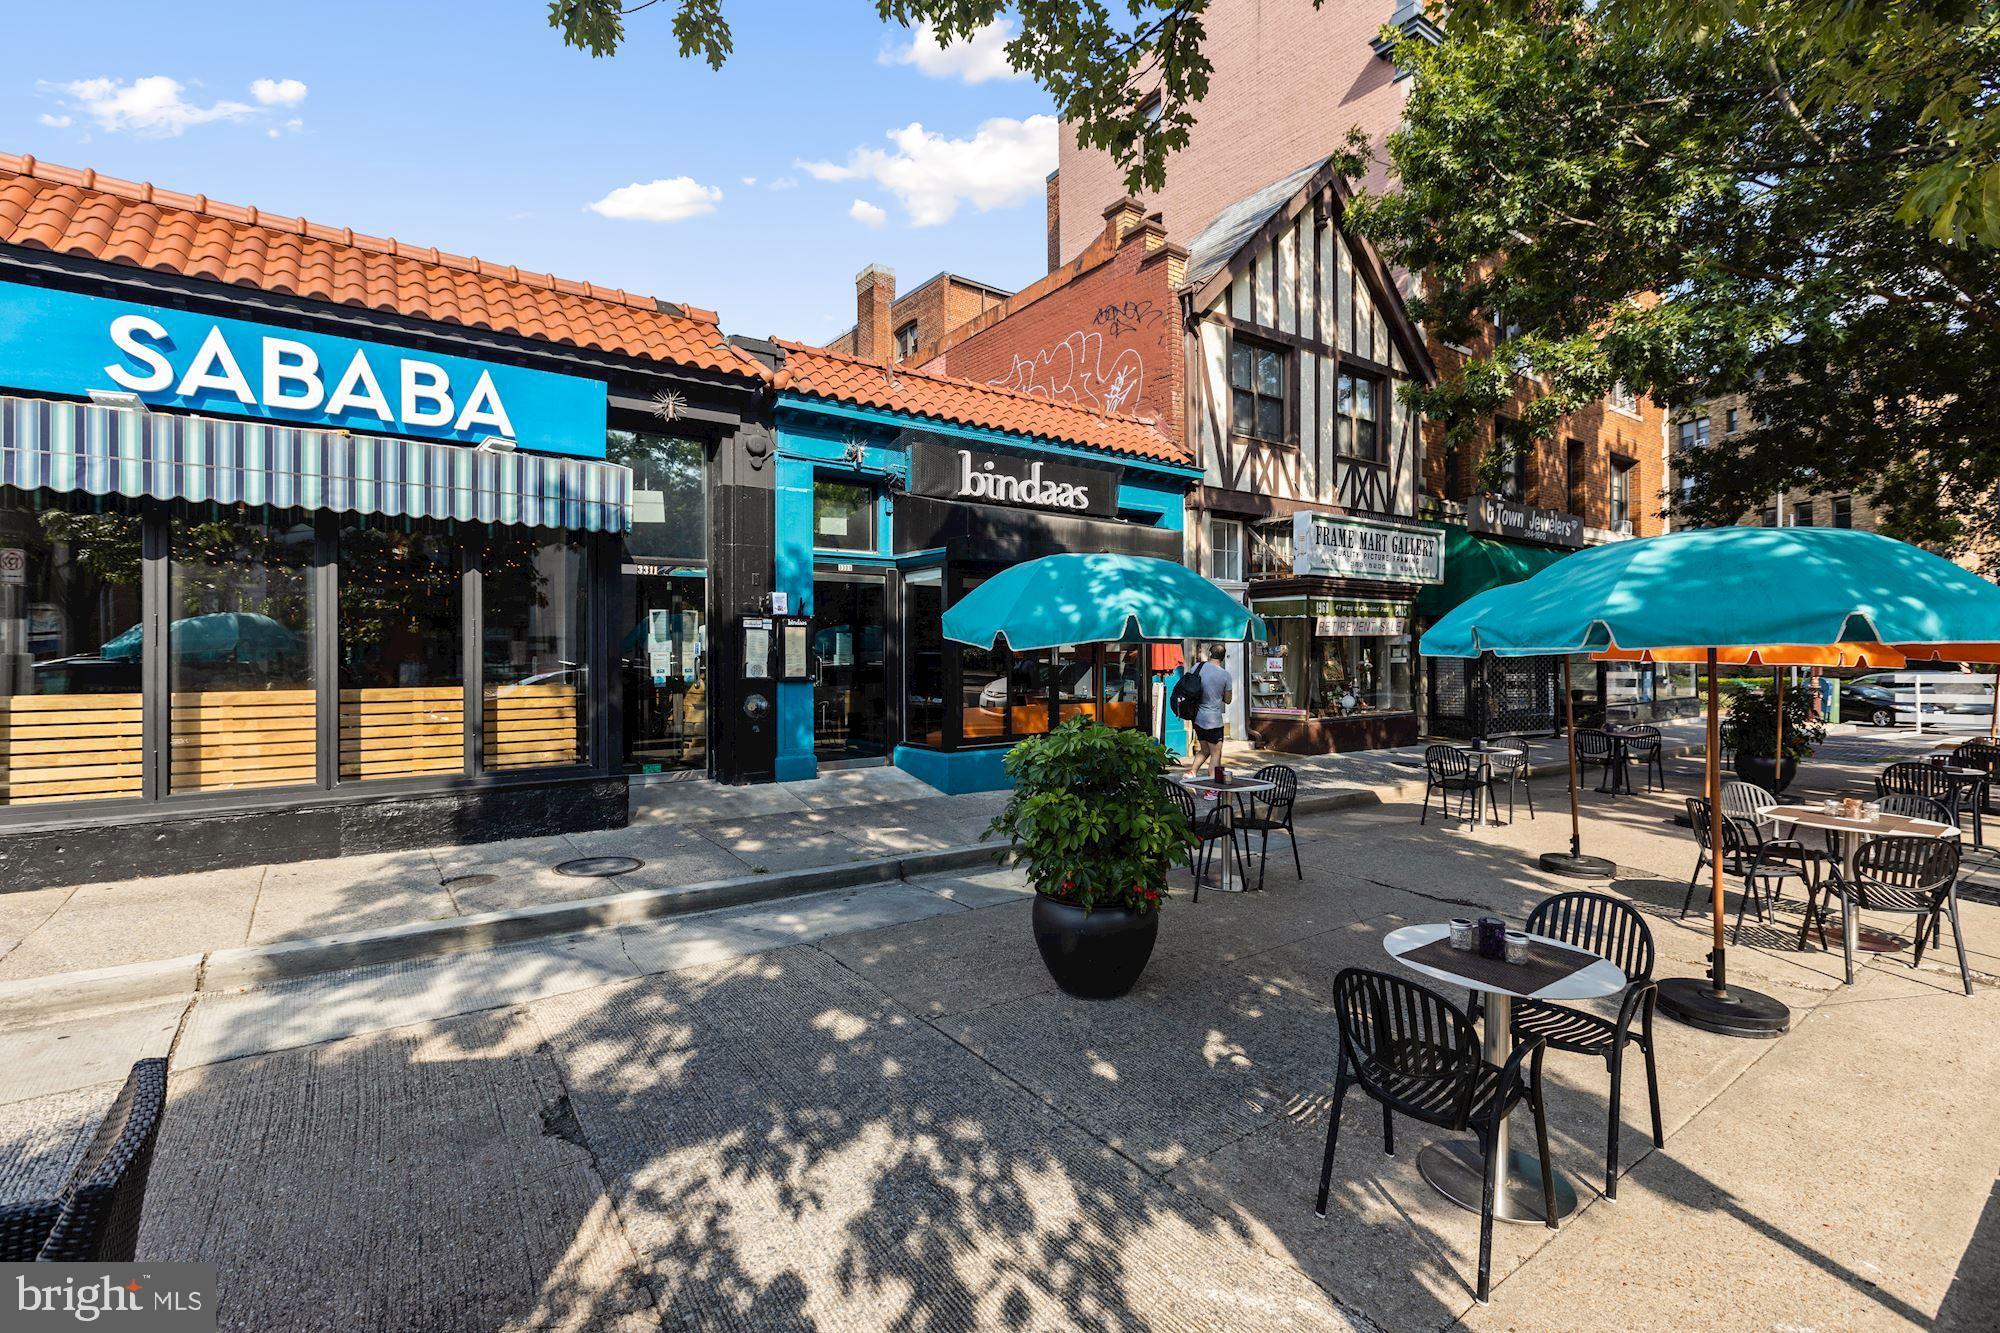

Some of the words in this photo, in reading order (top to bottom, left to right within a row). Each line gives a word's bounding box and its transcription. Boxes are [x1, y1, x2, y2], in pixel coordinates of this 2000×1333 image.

[104, 314, 516, 438] SABABA
[957, 449, 1089, 509] bindaas
[1528, 510, 1572, 537] Jewelers
[1315, 525, 1354, 549] FRAME
[1359, 531, 1388, 553] MART
[1391, 535, 1435, 558] GALLERY
[637, 564, 658, 576] 3311
[1333, 549, 1359, 559] QUALITY
[1363, 553, 1389, 562] PICTURE
[1392, 555, 1420, 565] FRAMING
[1318, 621, 1377, 633] RETIREMENT
[1379, 621, 1403, 632] SALE
